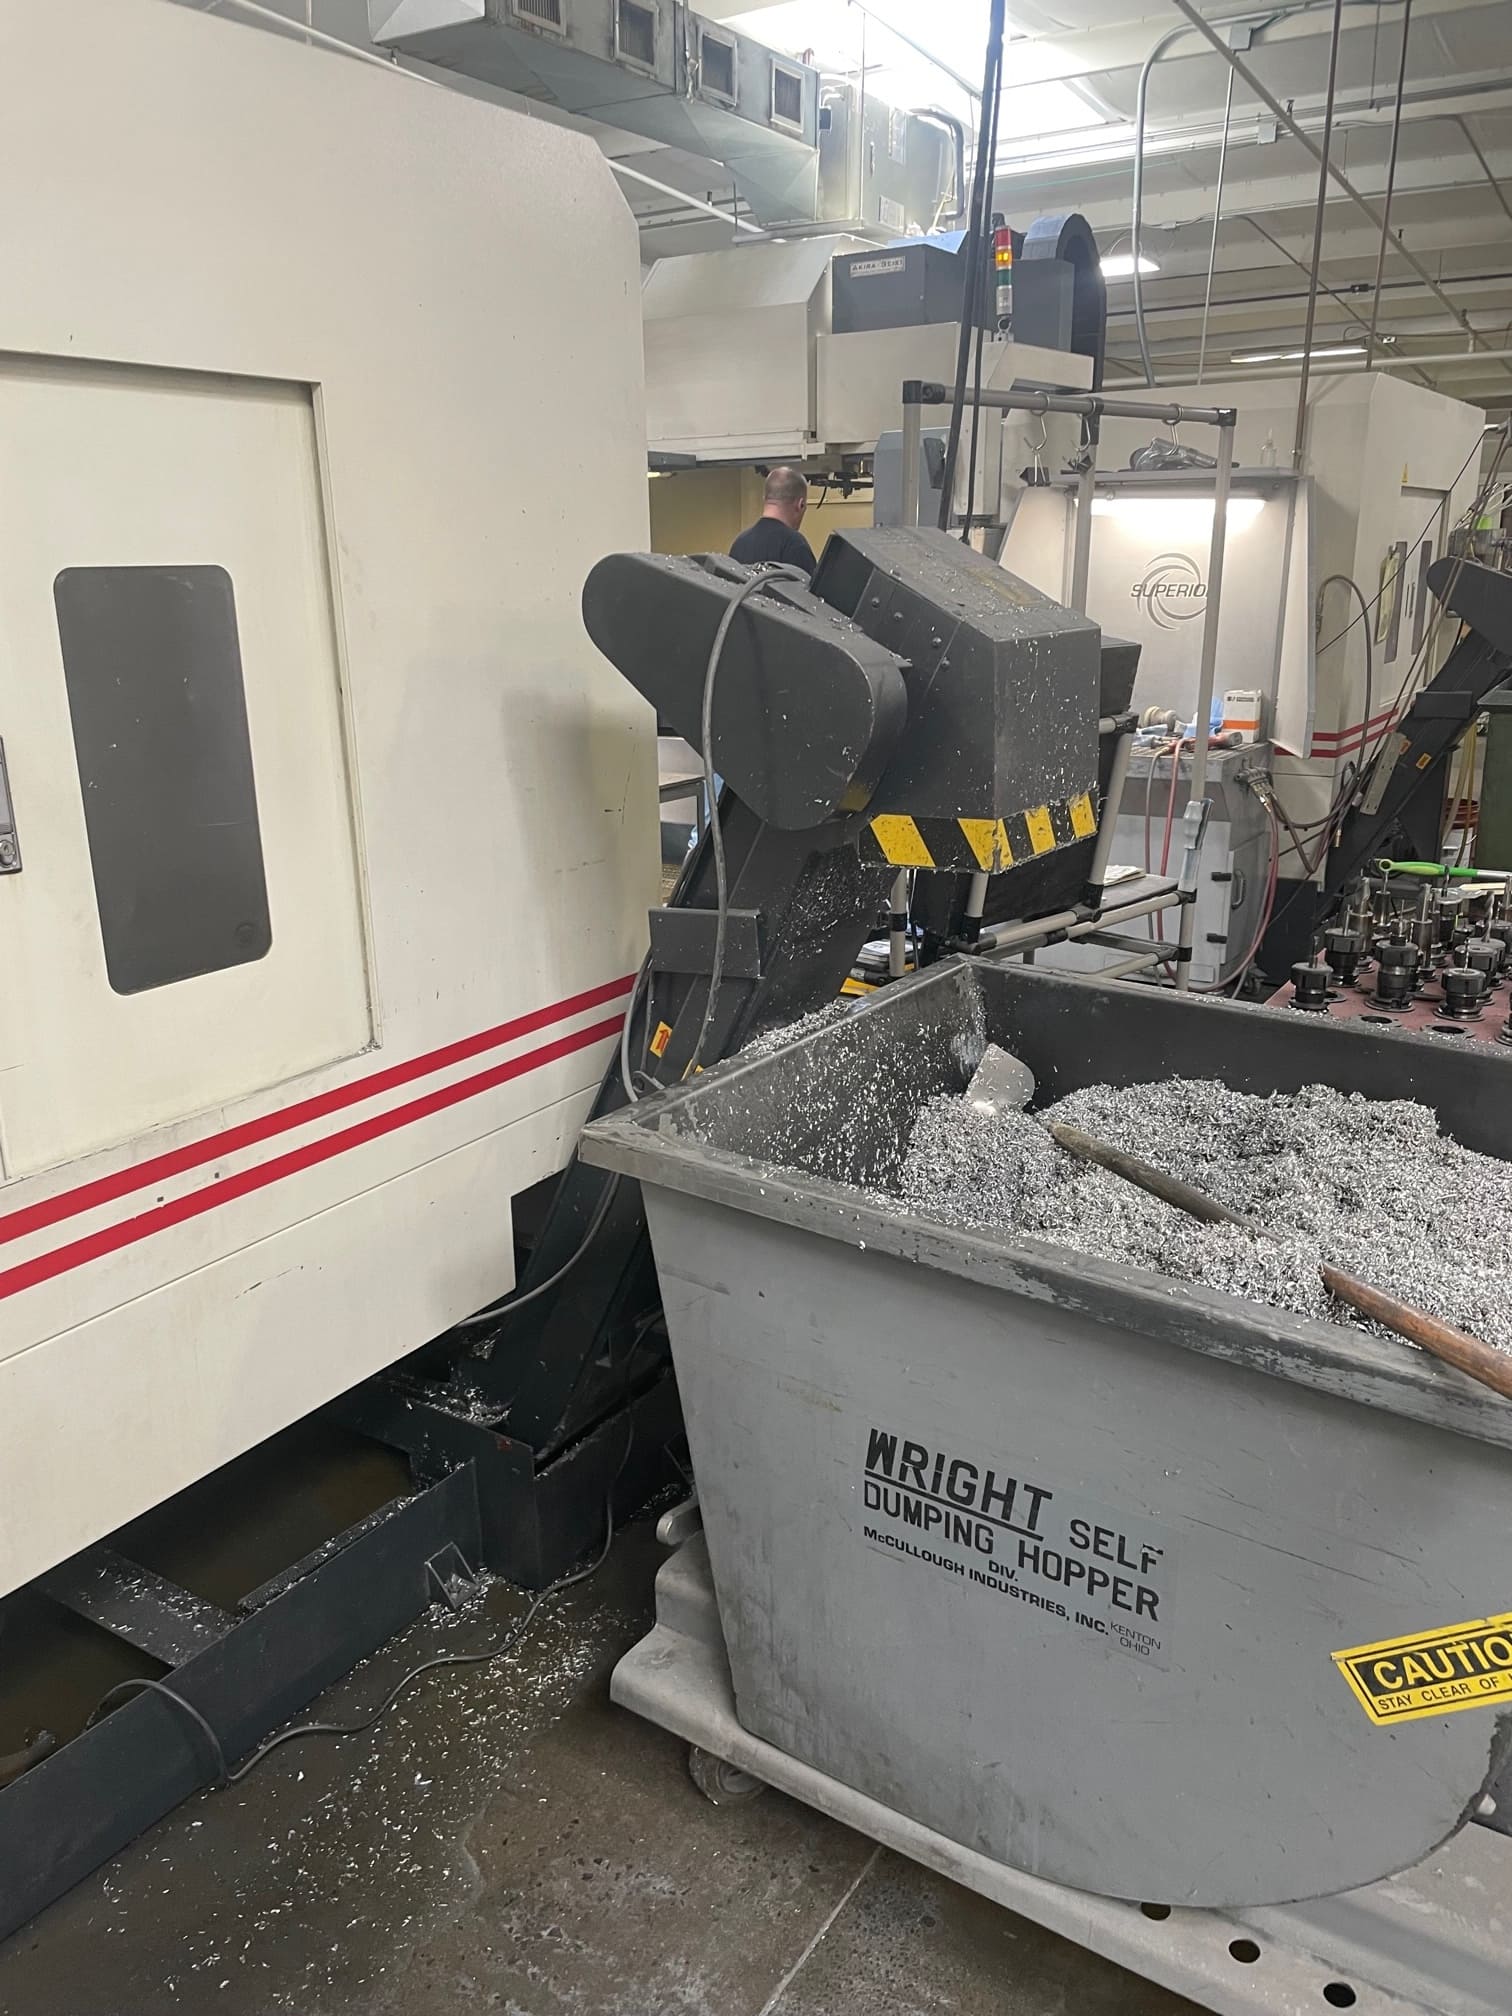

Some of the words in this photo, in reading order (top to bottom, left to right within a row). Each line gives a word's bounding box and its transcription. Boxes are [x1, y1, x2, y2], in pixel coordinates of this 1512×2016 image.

[1130, 583, 1207, 598] SUPERIO
[865, 1428, 1053, 1531] WRIGHT
[1069, 1519, 1164, 1575] SELF
[863, 1480, 995, 1555] DUMPING
[1017, 1539, 1160, 1622] HOPPER
[863, 1526, 965, 1576] McCULLOUGH
[968, 1568, 1070, 1621] INDUSTRIES,
[1075, 1611, 1109, 1636] INC.
[987, 1559, 1019, 1582] DIV.
[1110, 1621, 1161, 1650] KENTON
[1119, 1636, 1150, 1656] OHIO
[1373, 1634, 1512, 1690] CAUTIO
[1378, 1694, 1413, 1711] STAY
[1421, 1682, 1472, 1702] CLEAR
[1479, 1676, 1500, 1690] OF
